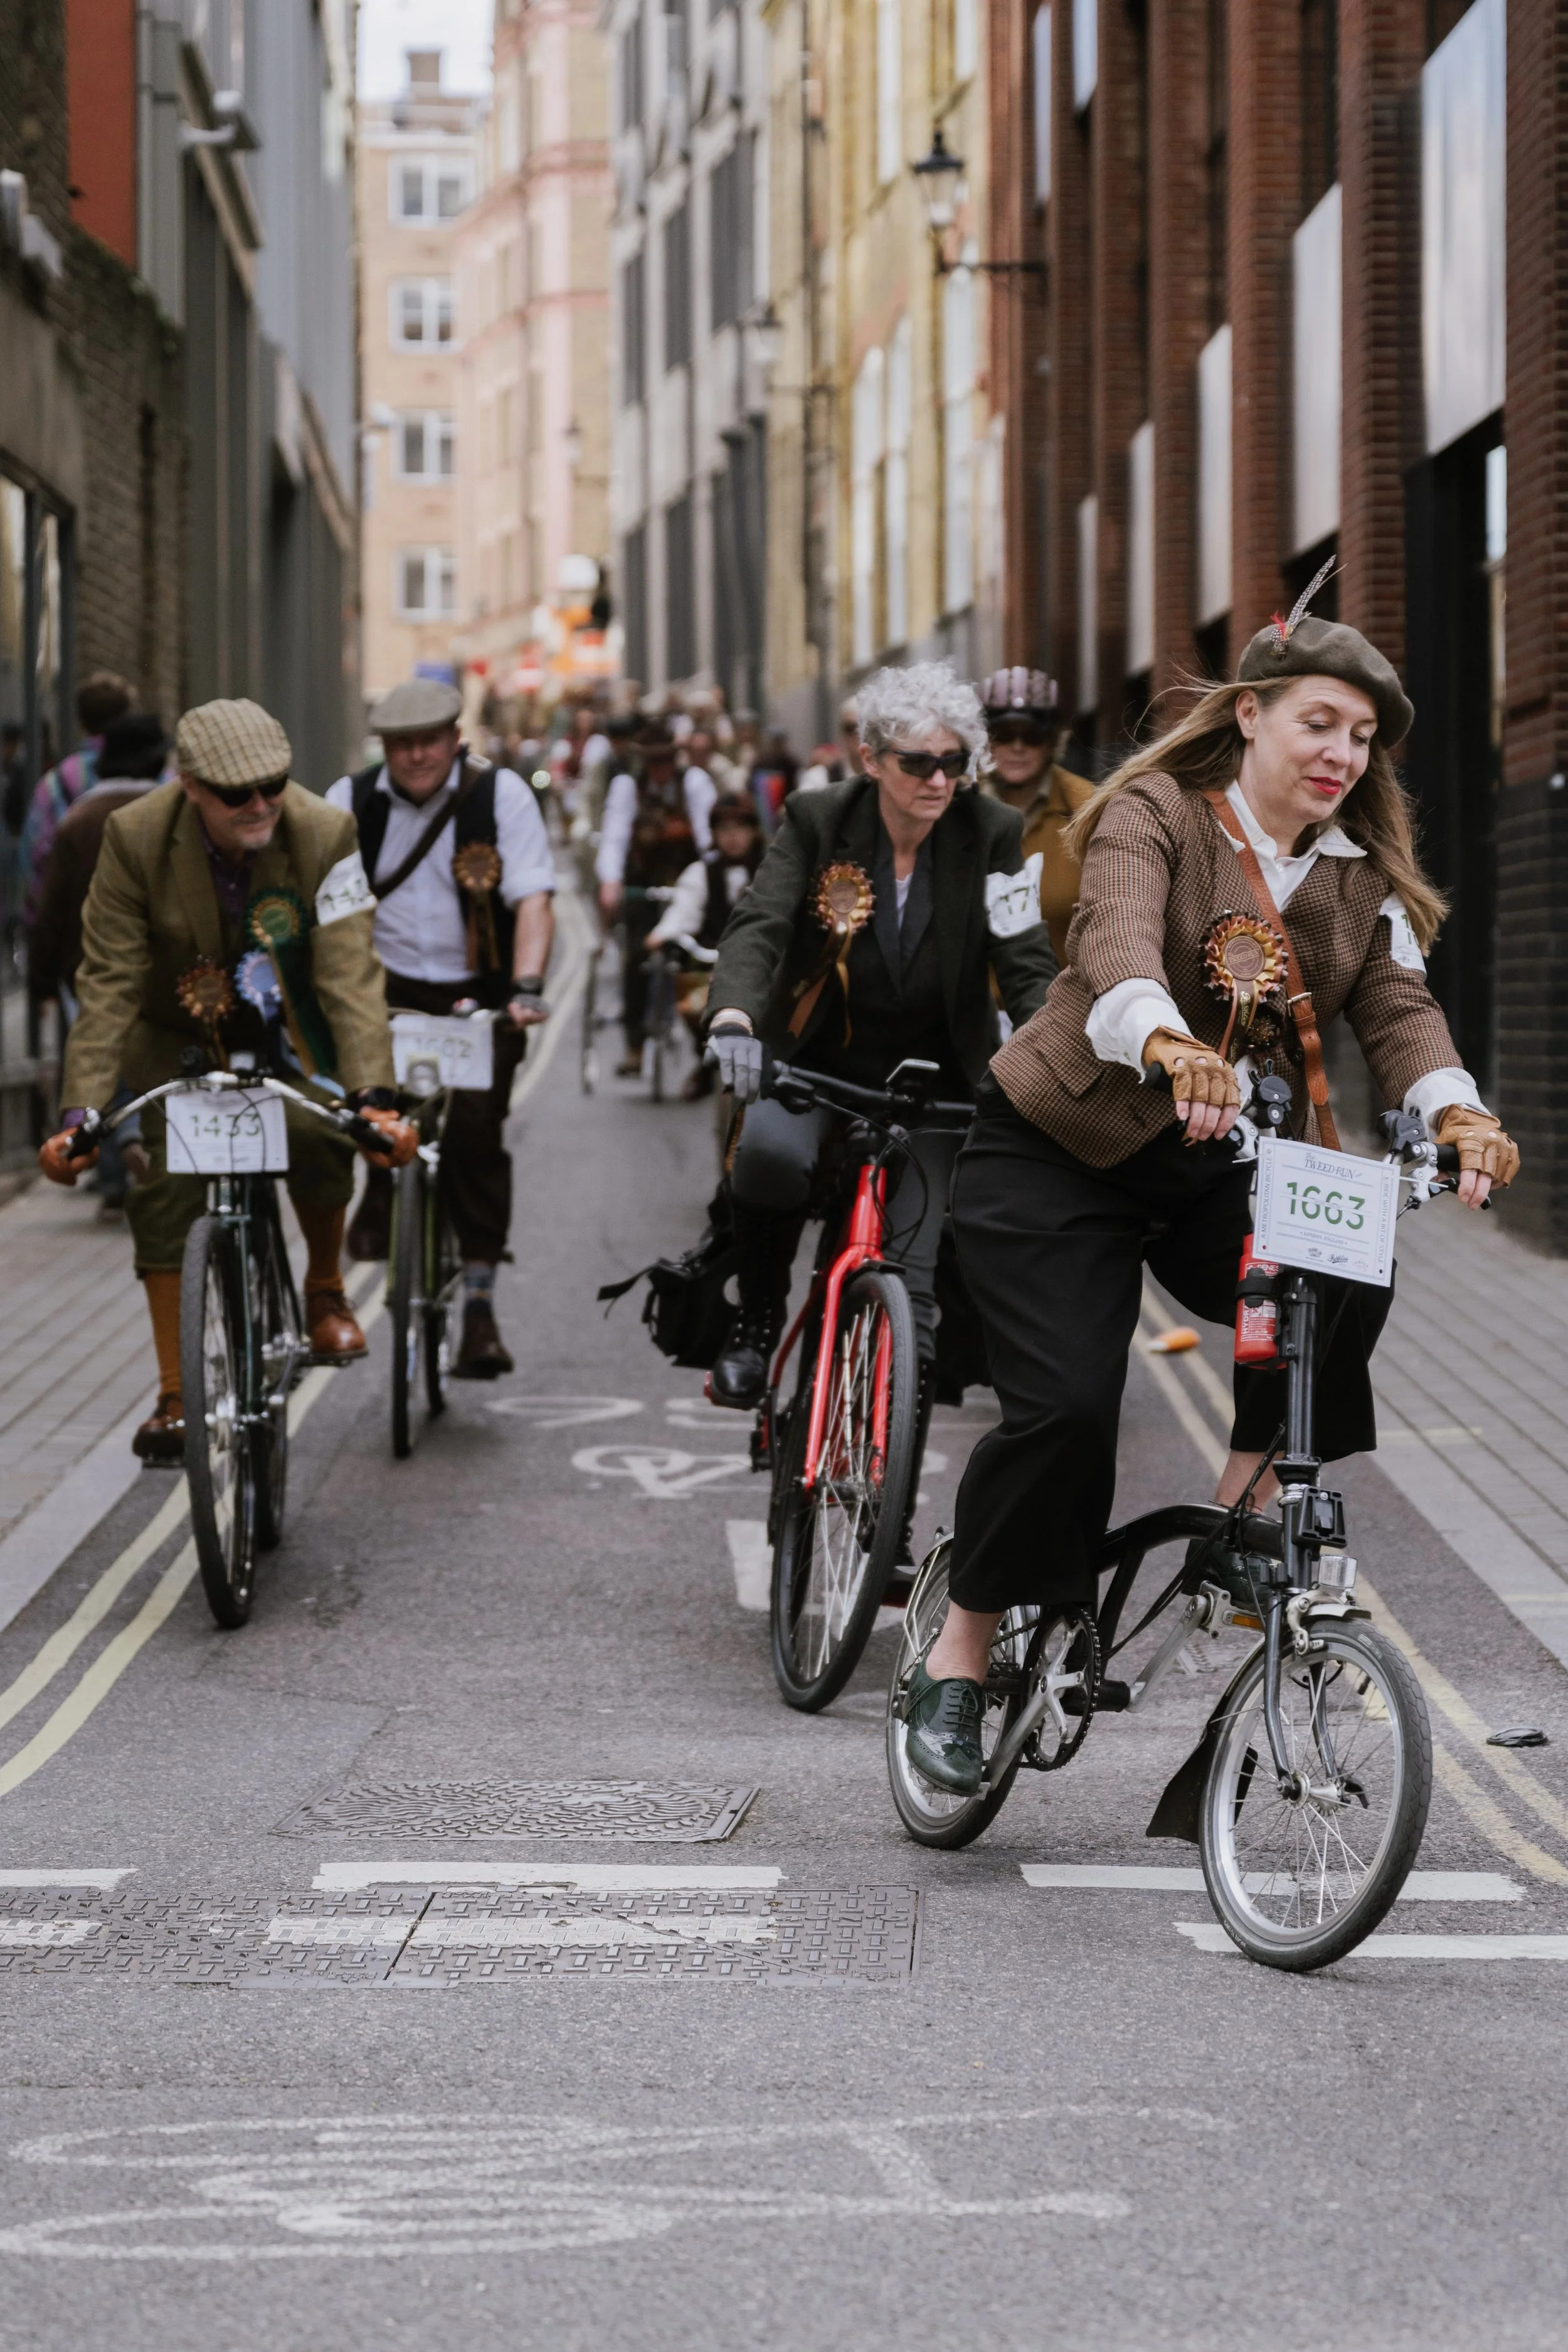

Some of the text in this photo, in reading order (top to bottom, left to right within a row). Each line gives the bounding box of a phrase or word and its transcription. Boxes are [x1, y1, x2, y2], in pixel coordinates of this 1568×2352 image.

[1305, 1159, 1356, 1179] TWEED RUN
[1261, 1184, 1270, 1233] METROPOLITAN
[1287, 1182, 1365, 1230] 1663
